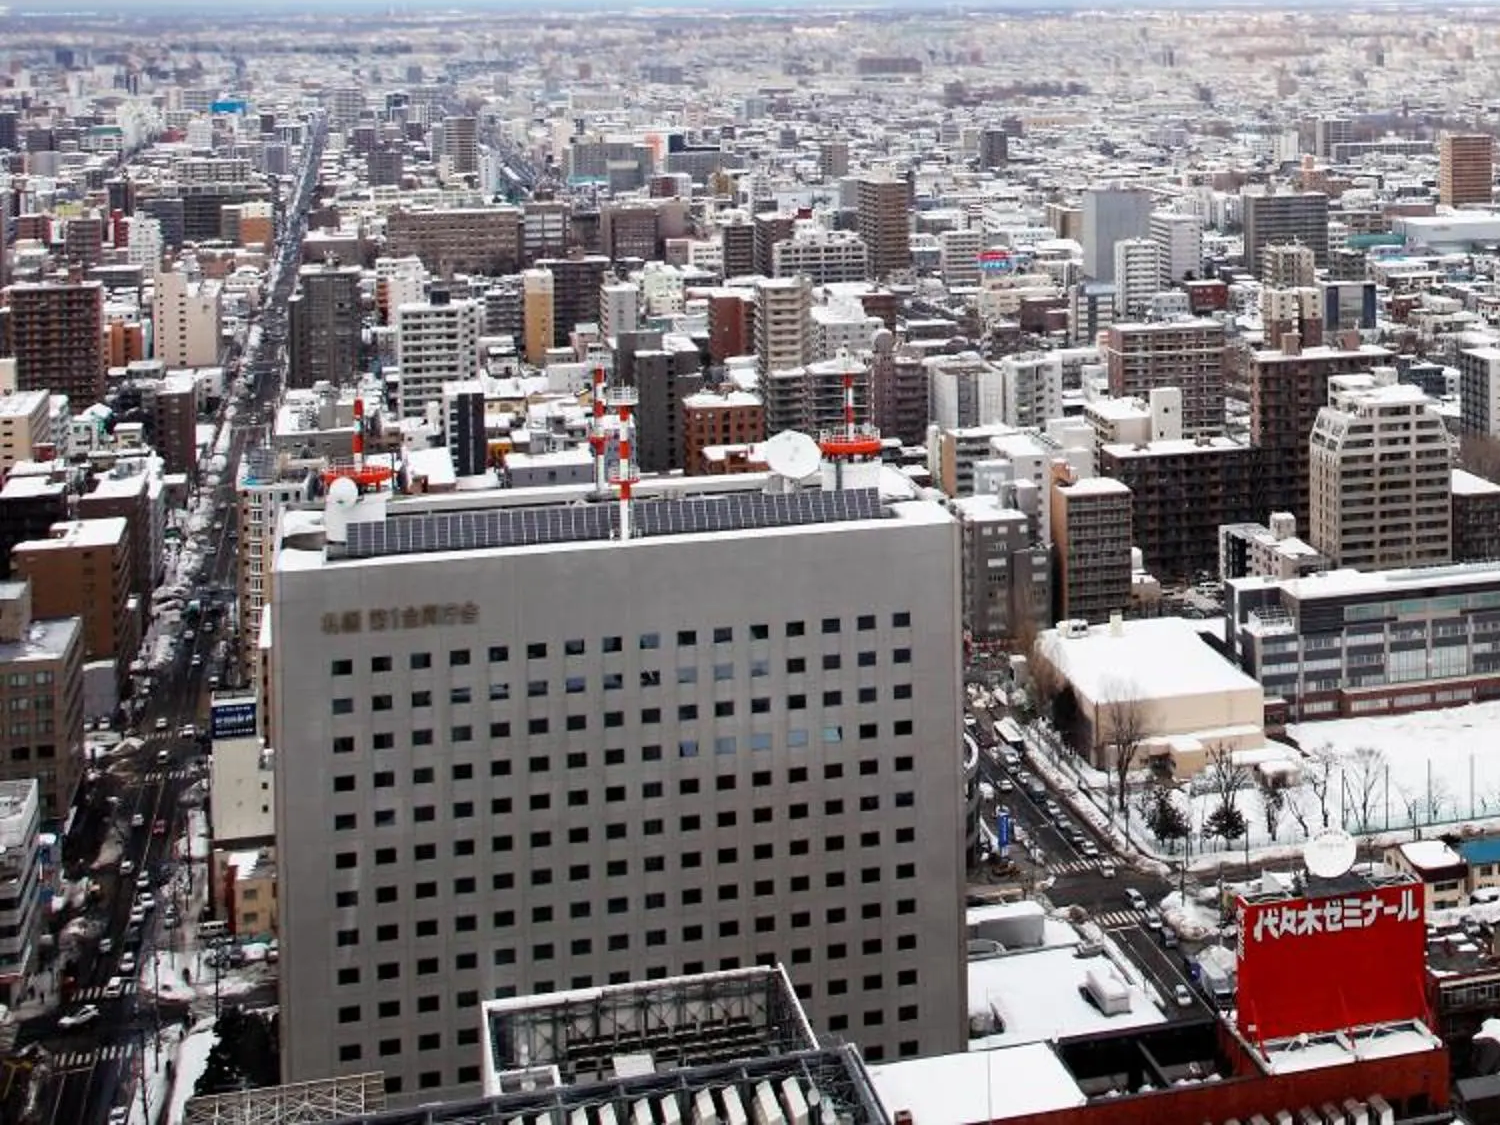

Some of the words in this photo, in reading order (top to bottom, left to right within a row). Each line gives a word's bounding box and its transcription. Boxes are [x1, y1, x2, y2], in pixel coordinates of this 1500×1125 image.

[1253, 889, 1419, 942] 代々木ゼミナール
